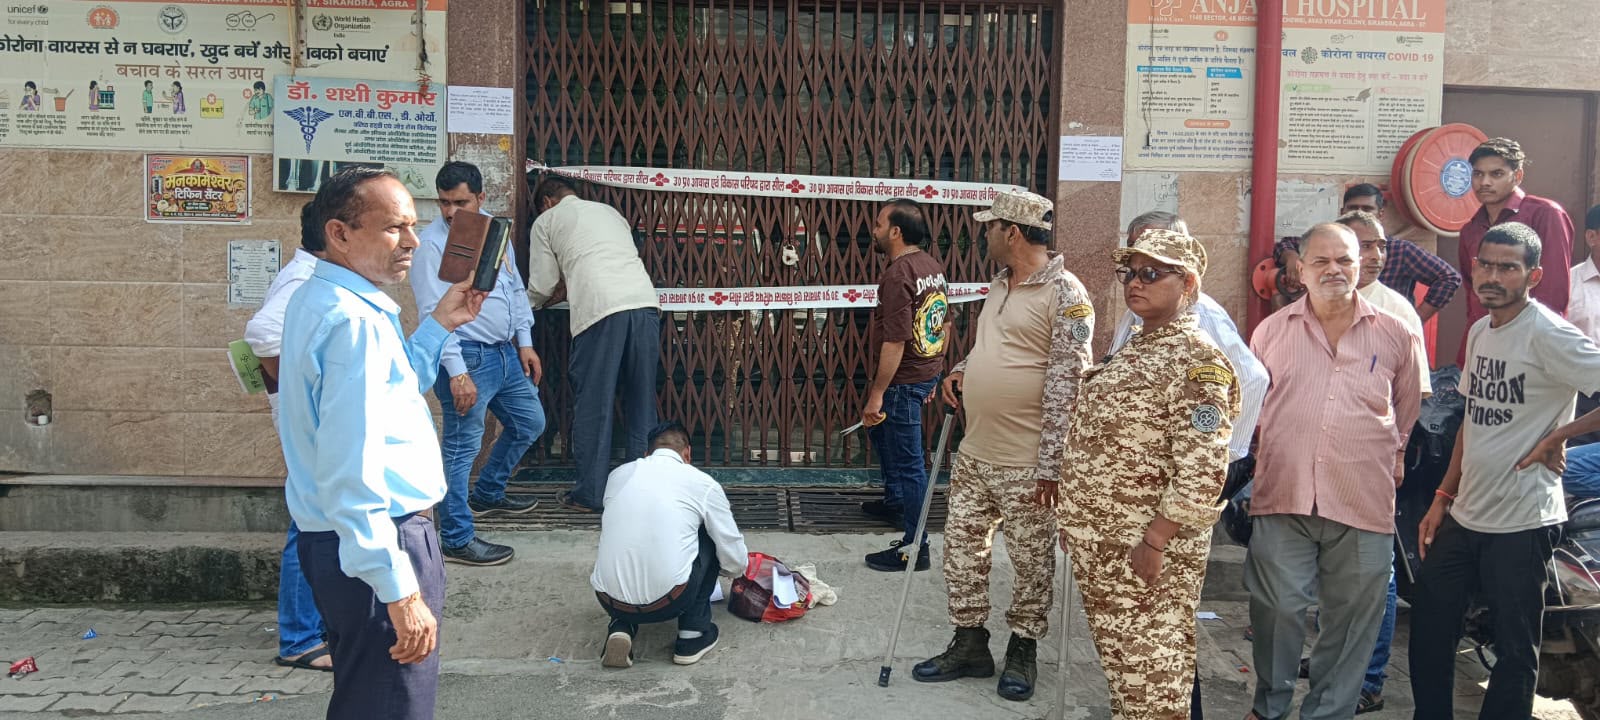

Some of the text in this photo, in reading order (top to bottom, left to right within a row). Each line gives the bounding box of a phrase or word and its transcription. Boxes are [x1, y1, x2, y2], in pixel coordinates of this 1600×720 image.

[7, 5, 36, 14] unicef
[1297, 0, 1427, 20] HOSPITAL
[48, 40, 100, 54] वायरस
[104, 37, 120, 54] से
[123, 42, 137, 54] न
[200, 44, 230, 64] खुद
[234, 41, 261, 58] बचें
[348, 45, 390, 62] बचाएं
[1321, 48, 1352, 59] कोरोना
[1356, 51, 1386, 61] वायरस
[1387, 52, 1434, 62] COVID 19
[115, 60, 265, 81] बचाव के सरल उपाय
[287, 81, 438, 110] डॉ. शशी कुमार
[165, 172, 234, 193] मनकामेश्वर
[636, 170, 649, 184] सील
[691, 177, 709, 188] आवास
[711, 176, 719, 189] एवं
[721, 175, 739, 189] विकास
[740, 175, 758, 189] परिषद
[760, 180, 770, 191] द्वारा
[772, 177, 785, 191] सील
[174, 187, 202, 200] टिफिन
[826, 183, 844, 195] आवास
[855, 181, 873, 195] विकास
[875, 182, 892, 195] परिषद
[893, 186, 904, 197] द्वारा
[906, 183, 918, 197] सील
[960, 189, 977, 199] आवास
[775, 291, 793, 306] विकास
[1476, 355, 1507, 381] TEAM
